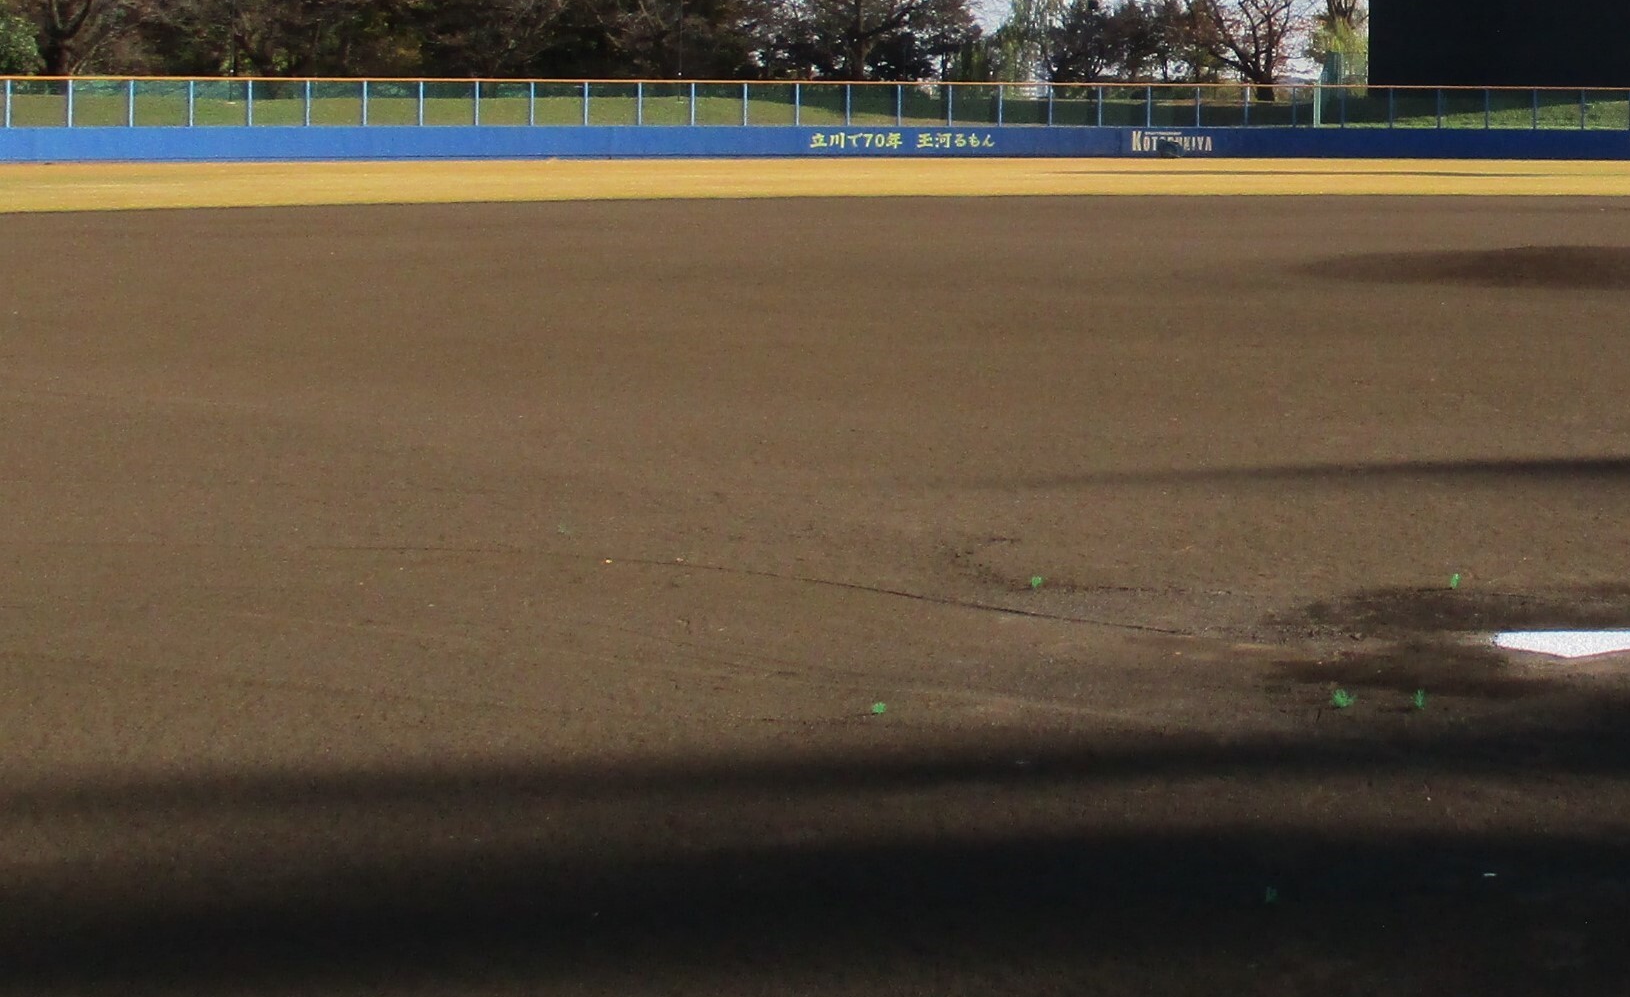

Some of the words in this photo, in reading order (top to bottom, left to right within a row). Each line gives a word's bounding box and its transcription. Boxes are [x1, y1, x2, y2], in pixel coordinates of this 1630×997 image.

[810, 132, 903, 149] 立川で70年
[1132, 130, 1213, 151] KOTKIYA
